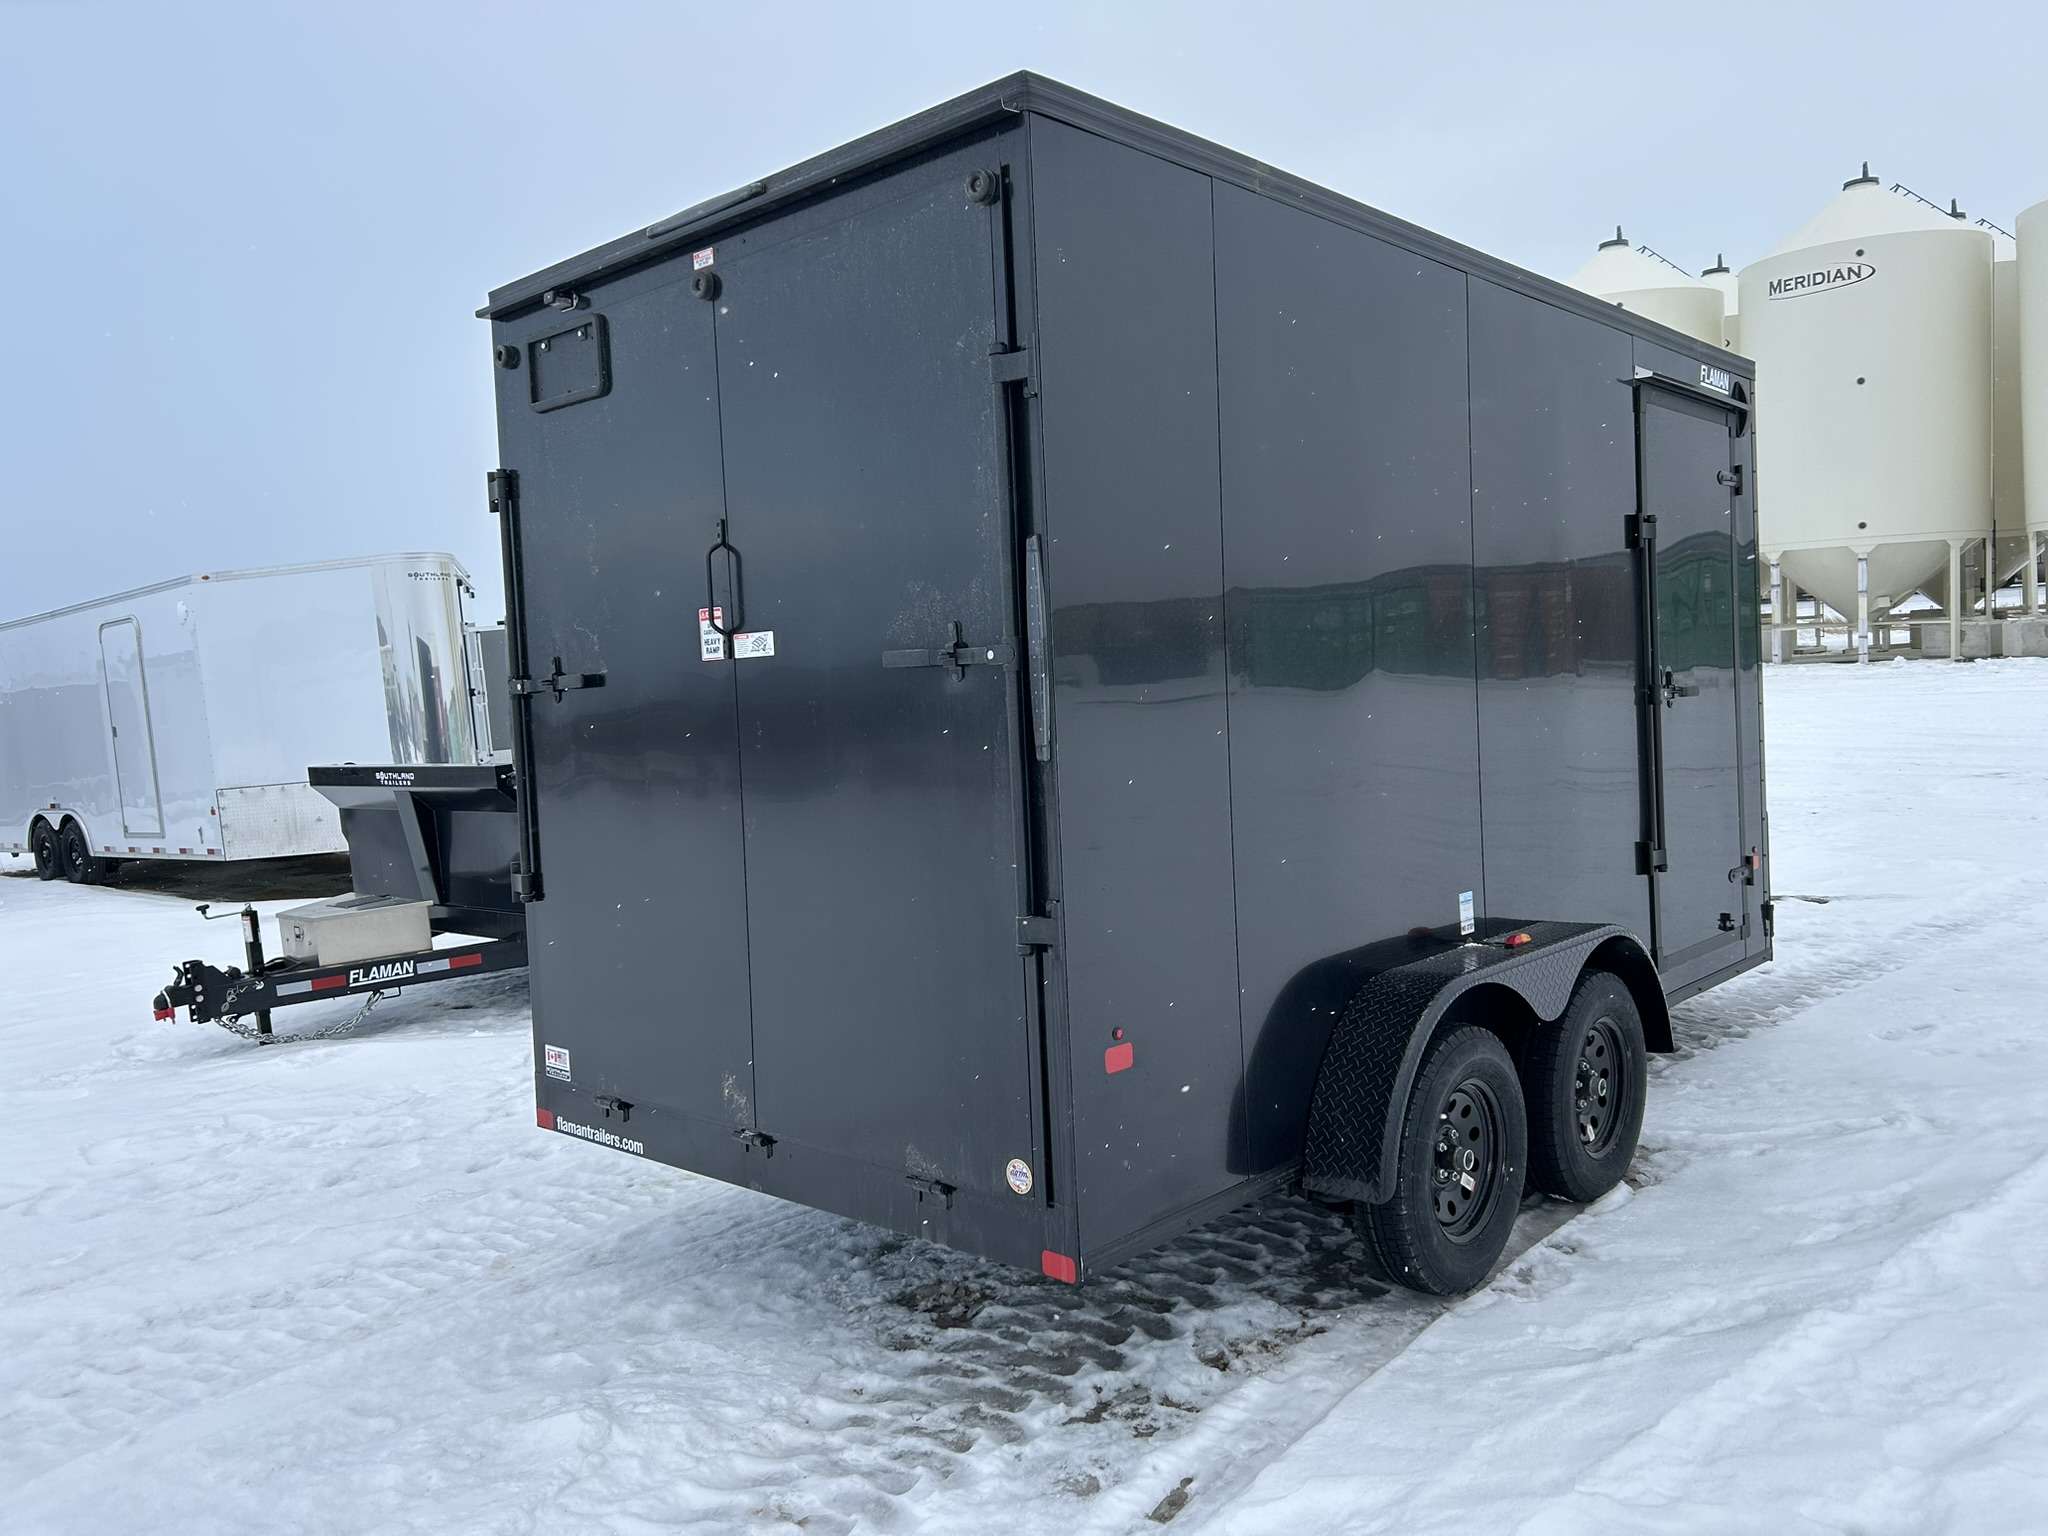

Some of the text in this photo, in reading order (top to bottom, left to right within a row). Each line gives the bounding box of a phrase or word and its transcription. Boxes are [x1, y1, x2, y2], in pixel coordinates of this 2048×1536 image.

[1769, 265, 1862, 296] MERIDIAN
[1701, 365, 1729, 391] FLAMAN
[375, 771, 415, 780] SOUTHLAND
[349, 960, 414, 984] FLAMAN
[556, 1115, 645, 1155] flamantrailers.com
